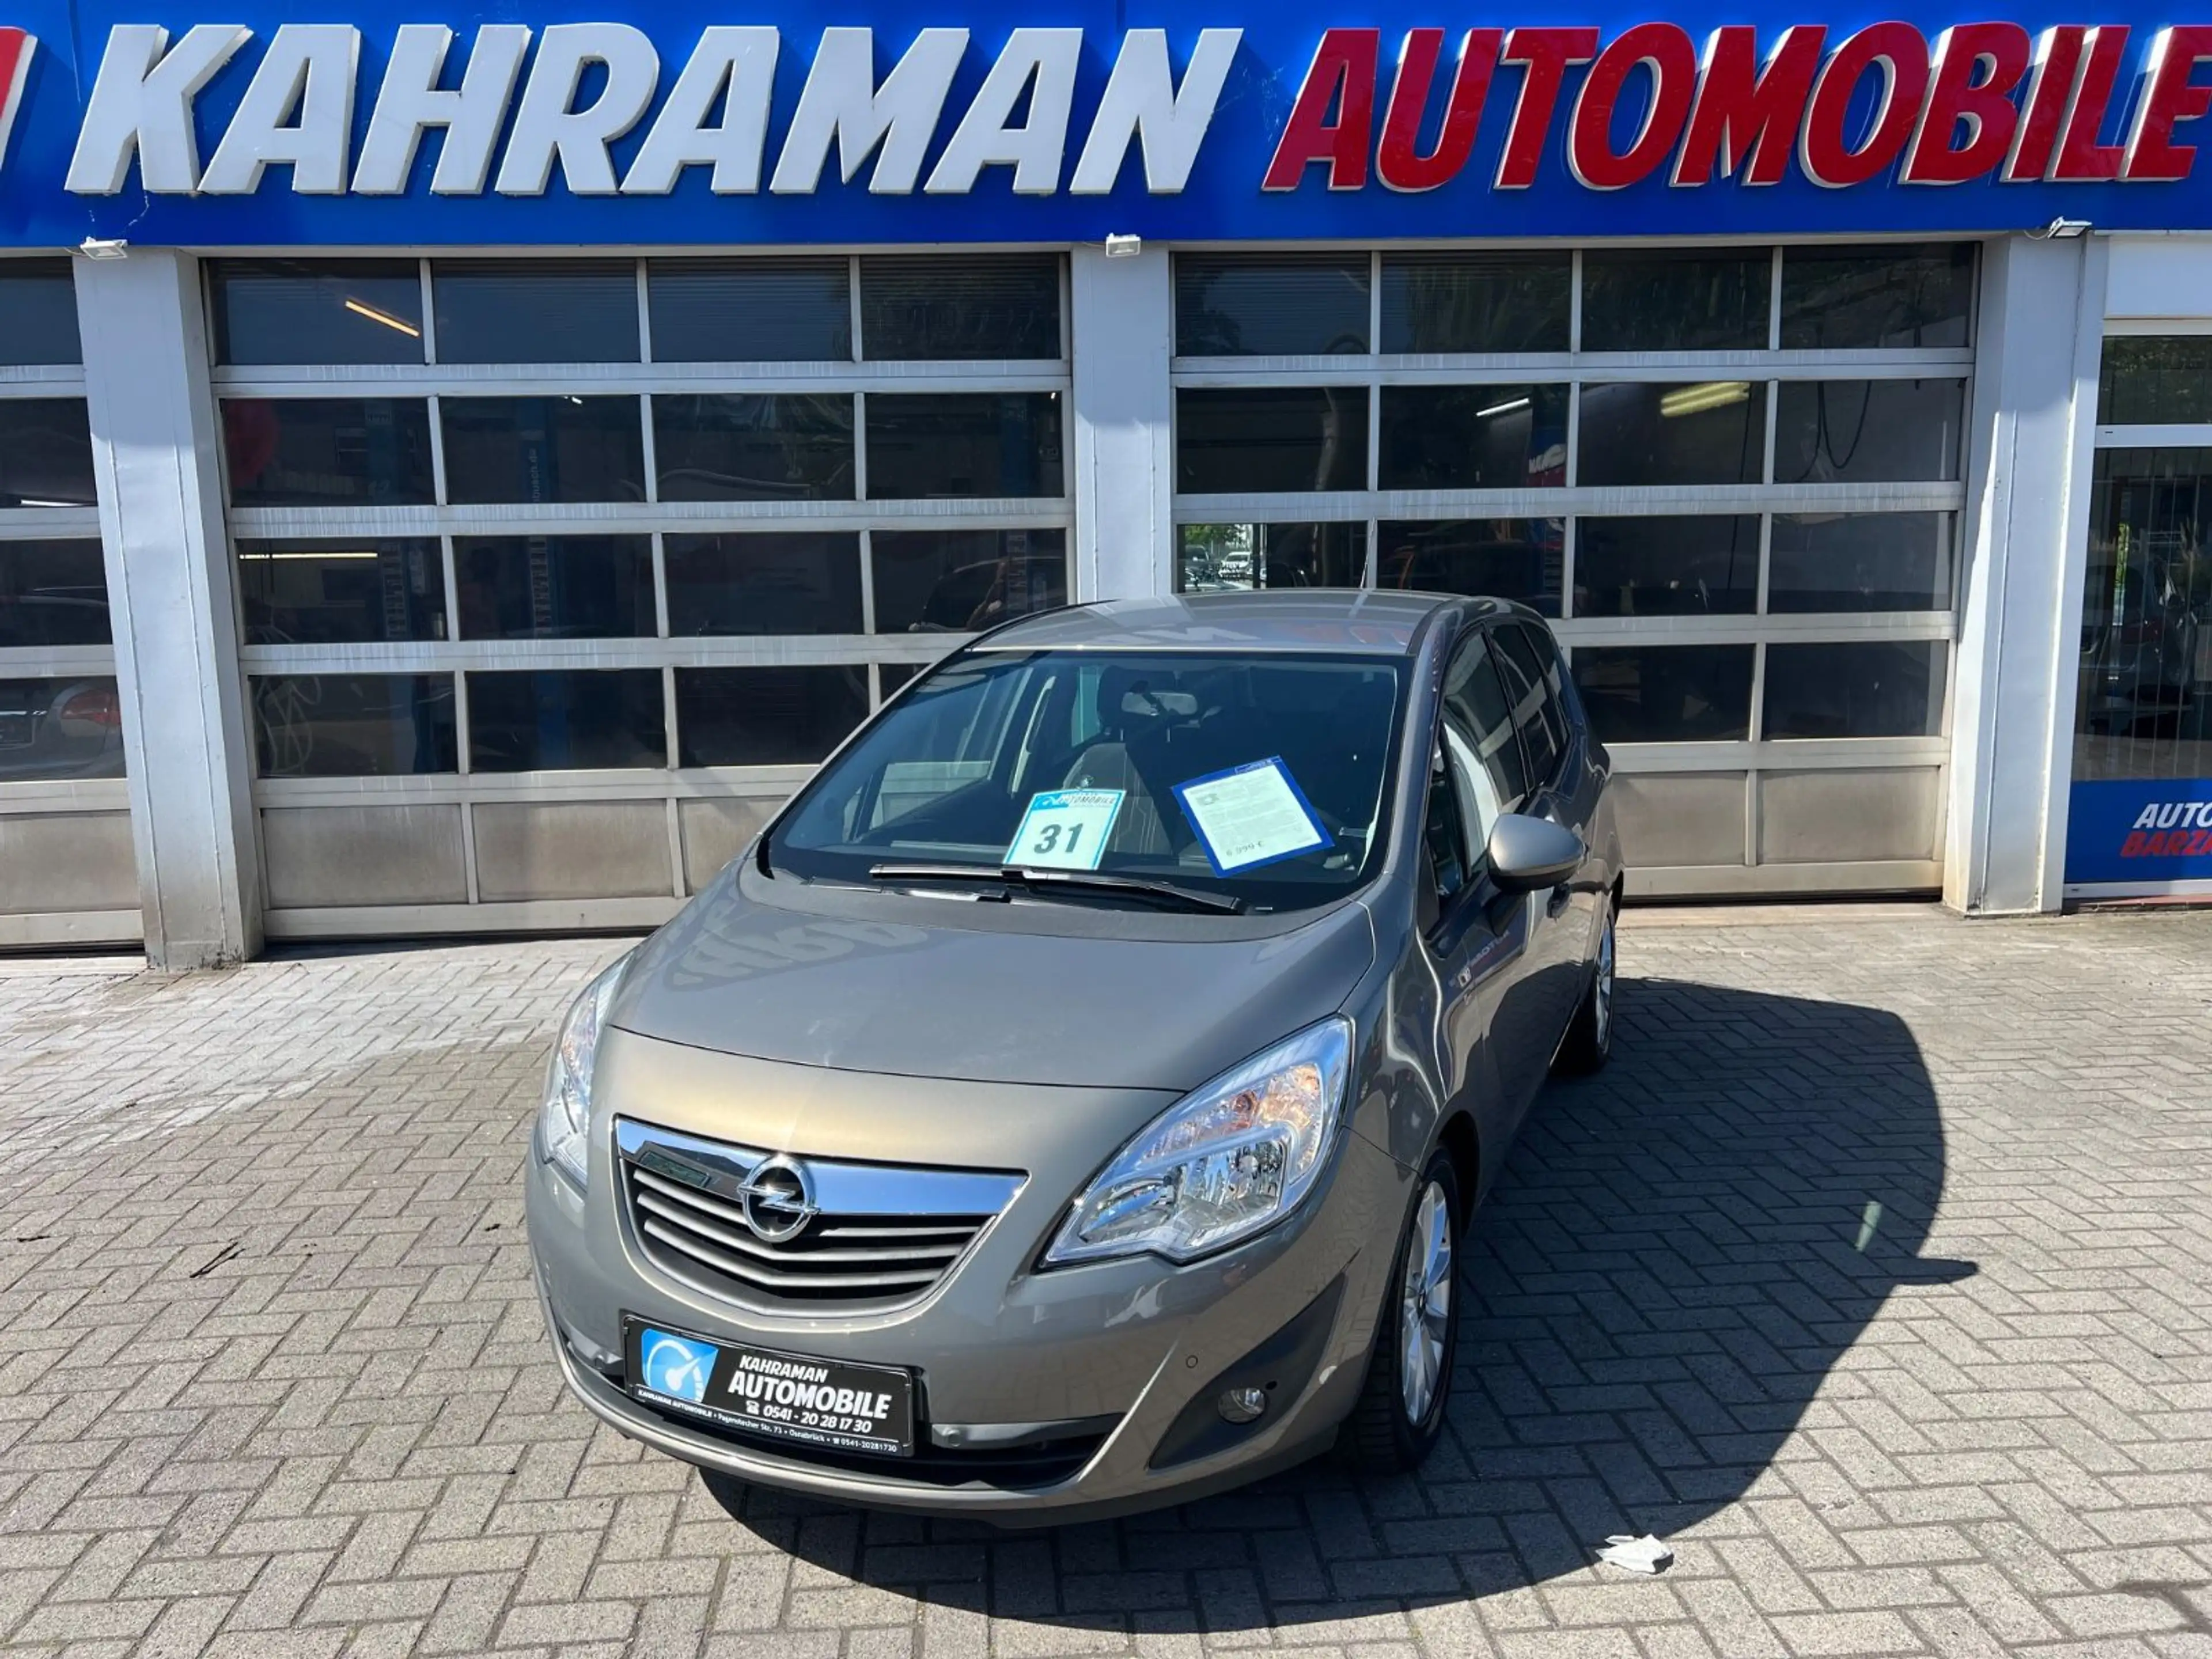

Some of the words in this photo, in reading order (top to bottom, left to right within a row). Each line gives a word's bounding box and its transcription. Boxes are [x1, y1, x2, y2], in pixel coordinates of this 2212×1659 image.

[65, 22, 1244, 195] KAHRAMAN
[1262, 21, 2212, 192] AUTOMOBILE
[1033, 823, 1084, 854] 31
[739, 1355, 828, 1383] KAHRAMAN
[728, 1370, 892, 1419] AUTOMOBILE
[763, 1404, 793, 1421] 0541
[801, 1412, 819, 1425] 20
[820, 1415, 837, 1429] 28
[839, 1417, 853, 1430] 17
[853, 1420, 872, 1433] 30
[774, 1425, 782, 1434] 73
[789, 1429, 825, 1442] Osnabrück
[841, 1440, 897, 1453] 0541-20281730
